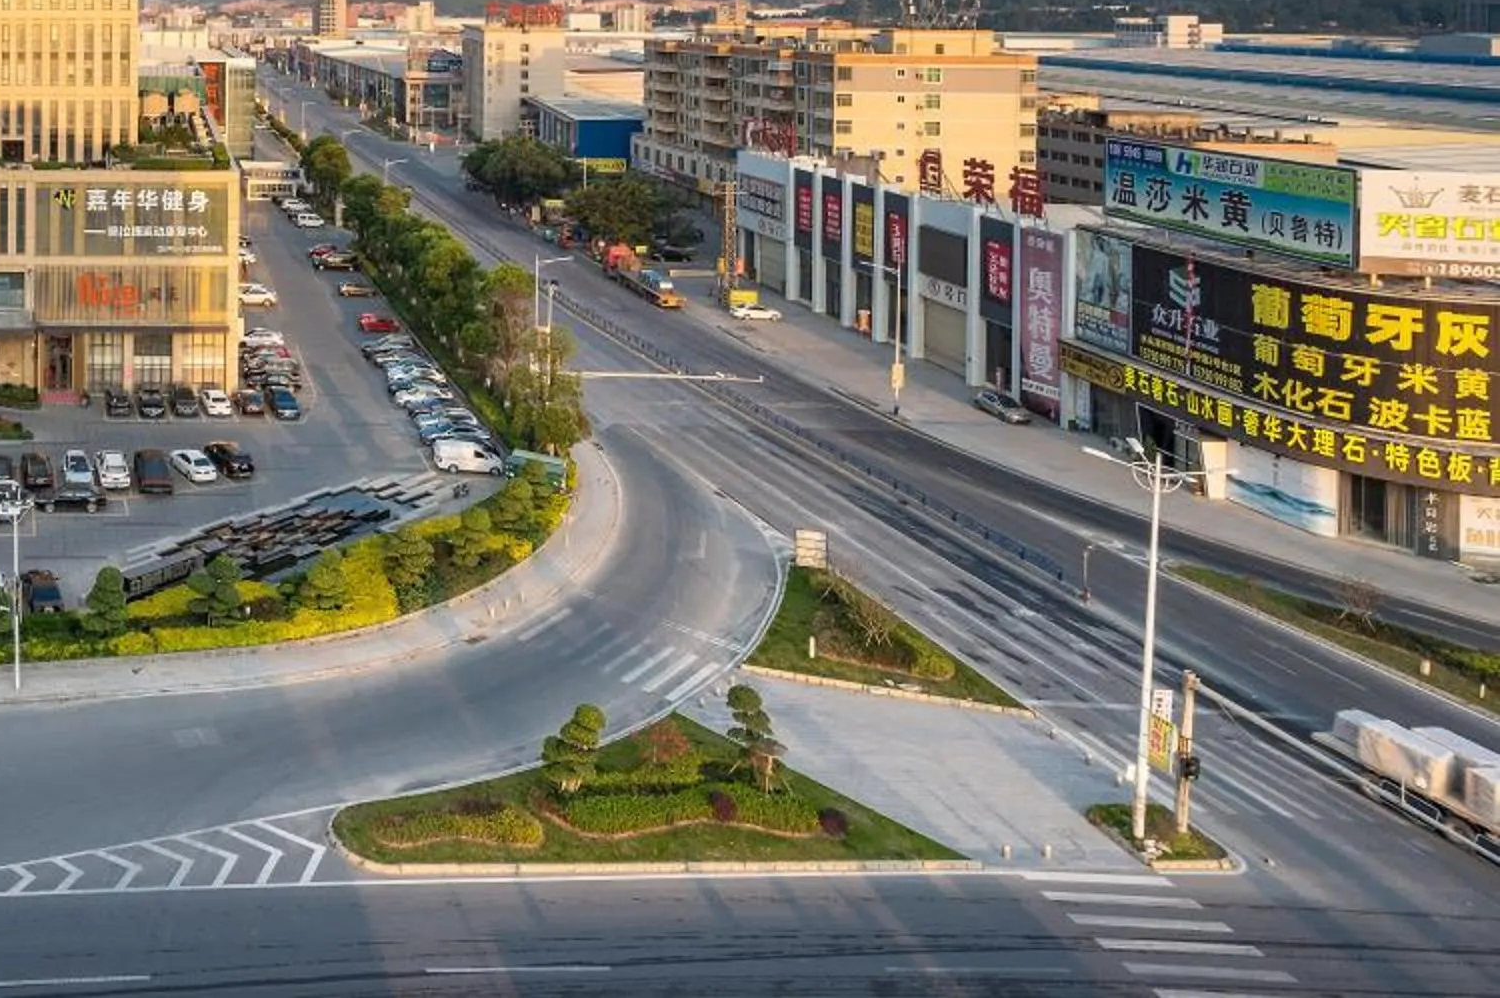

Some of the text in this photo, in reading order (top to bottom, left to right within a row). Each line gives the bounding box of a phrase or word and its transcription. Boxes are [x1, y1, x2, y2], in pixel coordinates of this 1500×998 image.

[86, 188, 210, 212] 嘉年华健身
[1112, 171, 1252, 232] 温莎米黄
[1251, 283, 1491, 359] 葡萄牙灰
[1252, 332, 1491, 401] 葡萄牙米黄
[1252, 370, 1492, 441] 木化石 波卡蓝
